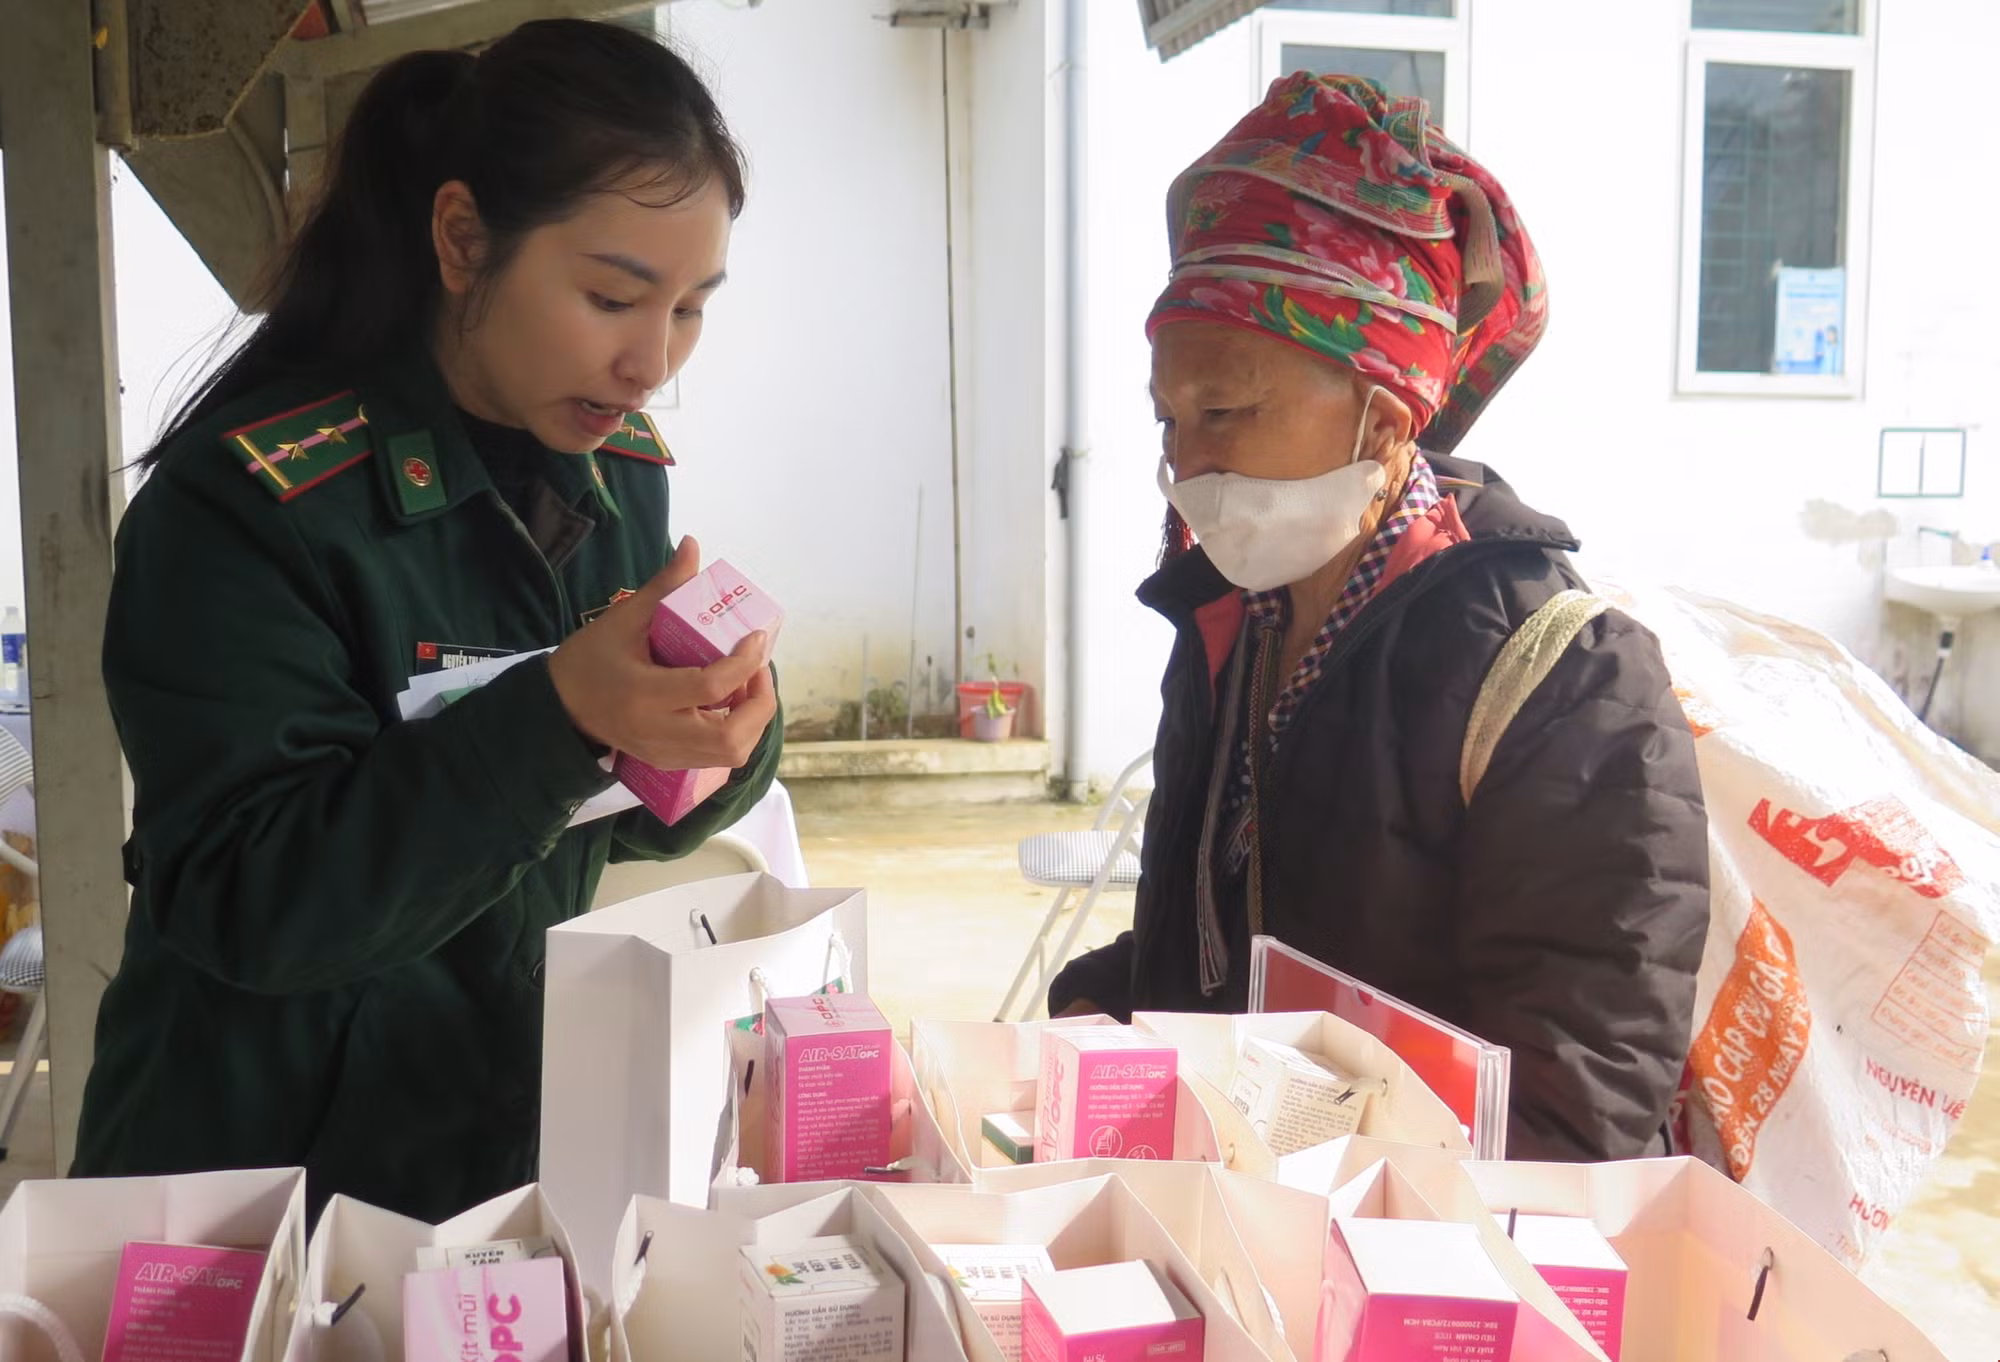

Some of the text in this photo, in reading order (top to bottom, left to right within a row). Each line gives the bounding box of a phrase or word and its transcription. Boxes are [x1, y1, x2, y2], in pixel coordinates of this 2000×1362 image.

[709, 585, 747, 614] OPC
[798, 1045, 863, 1063] AIR-SAT
[1090, 1064, 1152, 1079] AIR-SAT
[1751, 1081, 1776, 1114] 28
[135, 1261, 223, 1287] AIR-SAT
